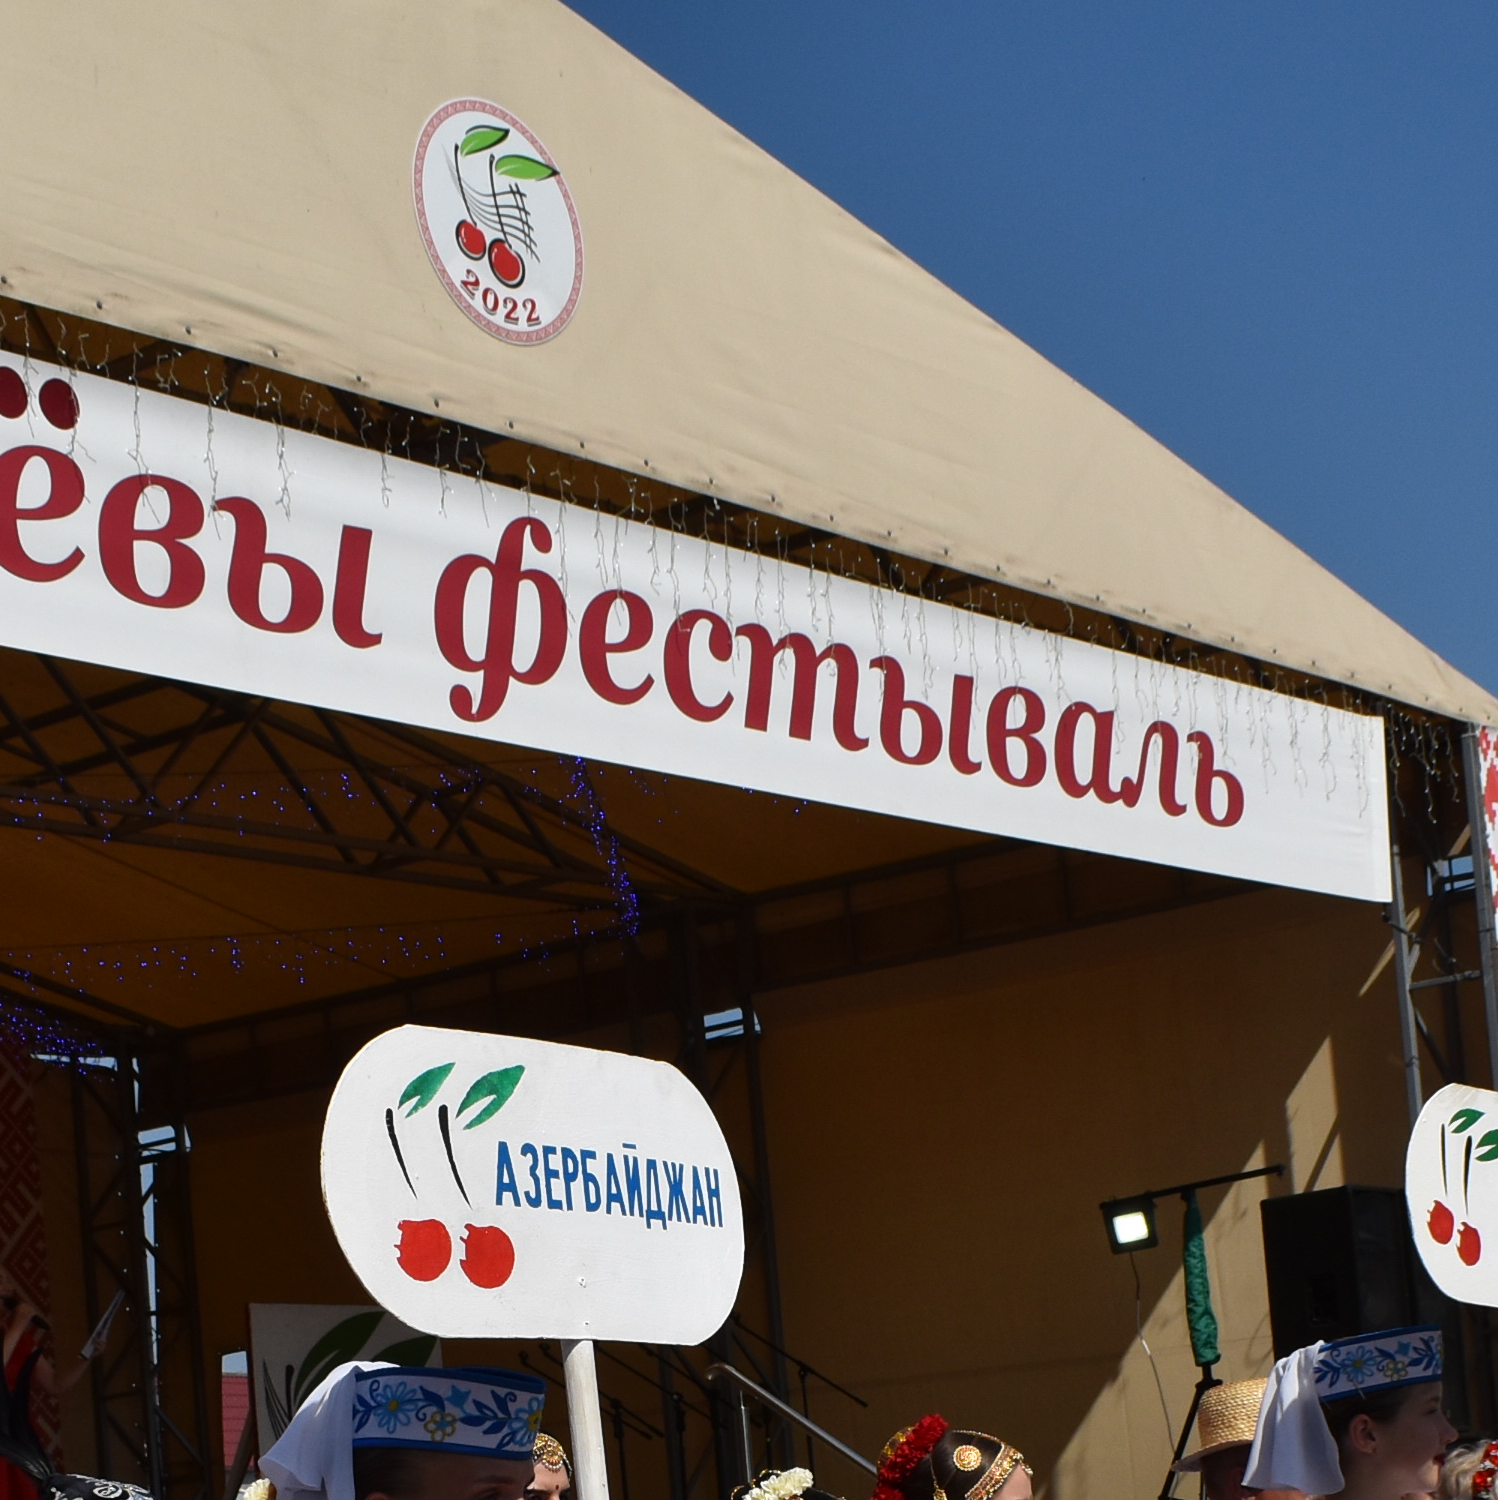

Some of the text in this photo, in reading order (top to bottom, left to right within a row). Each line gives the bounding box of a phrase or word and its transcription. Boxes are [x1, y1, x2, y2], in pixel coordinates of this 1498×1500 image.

[460, 268, 542, 327] 2022
[433, 516, 1245, 828] фестываль
[495, 1142, 724, 1230] АЗЕРБАЙДЖАН
